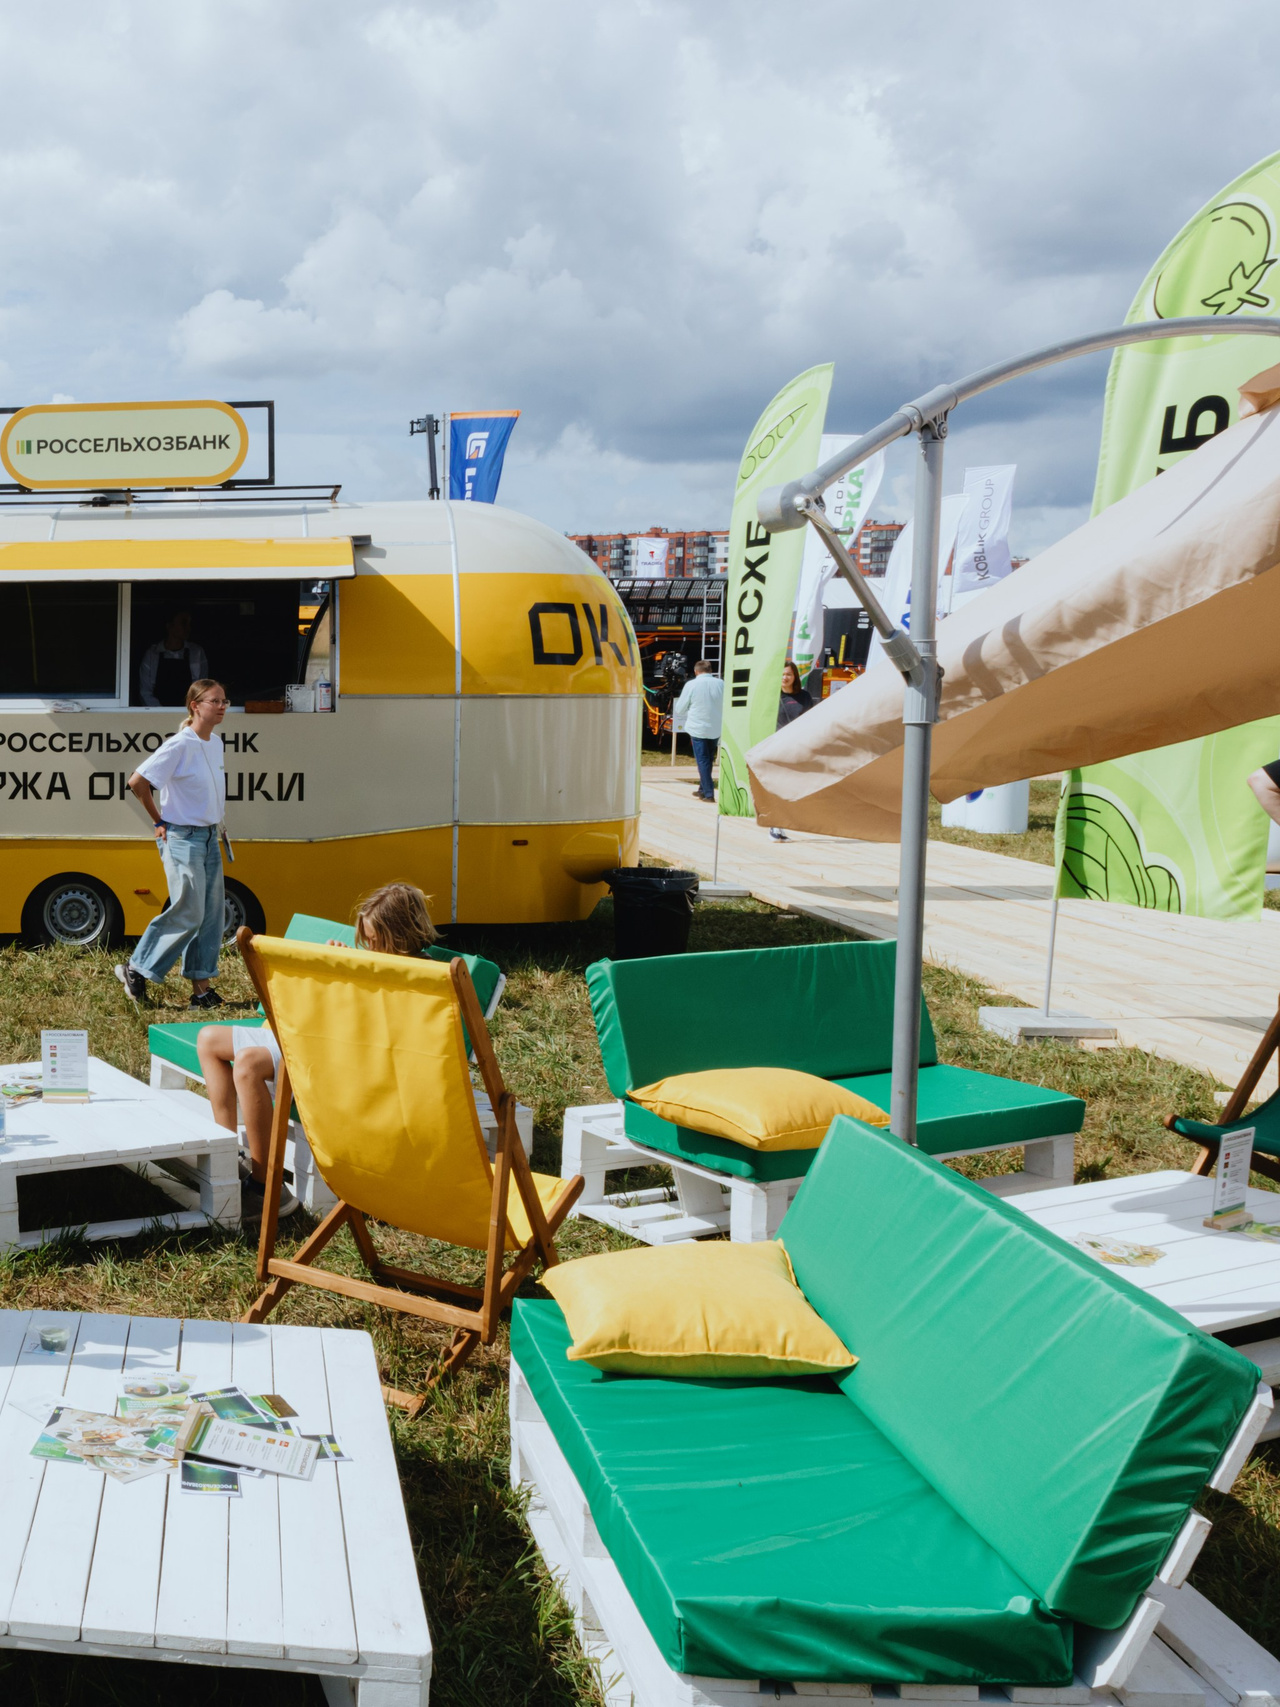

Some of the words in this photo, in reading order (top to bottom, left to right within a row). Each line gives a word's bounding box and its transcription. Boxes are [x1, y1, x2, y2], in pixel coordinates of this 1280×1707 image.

[36, 434, 231, 454] РОССЕЛЬХОЗБАНК
[978, 478, 995, 530] GROUP
[974, 533, 990, 581] KOBLIK
[734, 520, 771, 656] РСХБ
[528, 602, 634, 667] ОК
[88, 772, 304, 801] ОКШКИ
